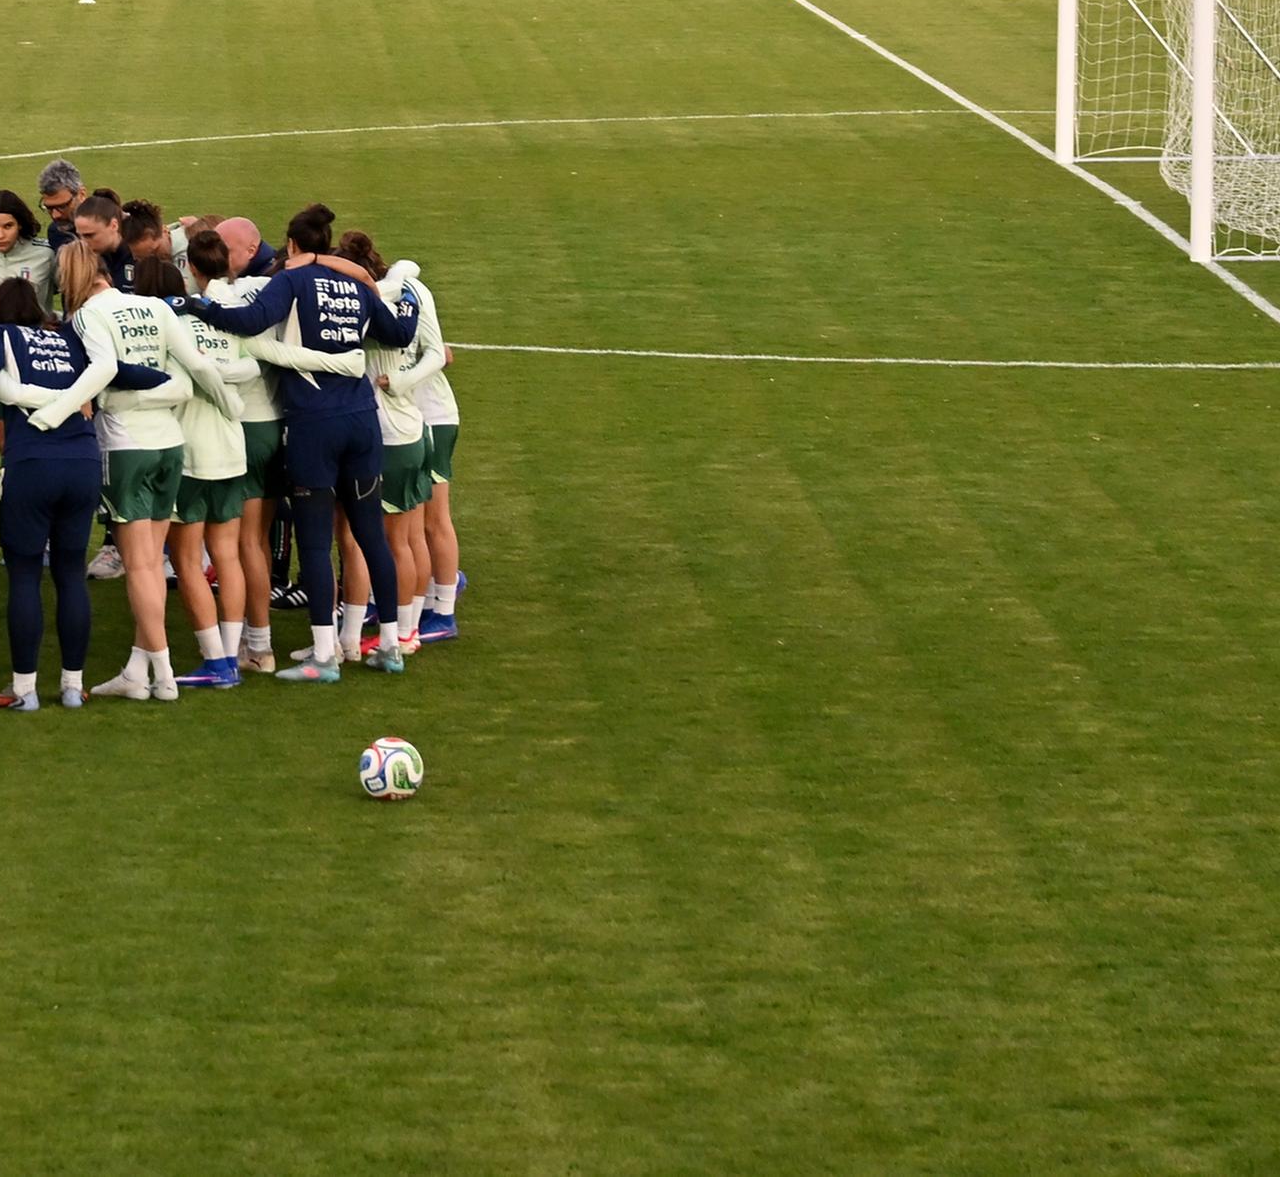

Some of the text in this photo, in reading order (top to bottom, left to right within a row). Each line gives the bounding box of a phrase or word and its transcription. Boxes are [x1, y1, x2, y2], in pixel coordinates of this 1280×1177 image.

[330, 280, 359, 295] TIM
[317, 291, 361, 310] Poste
[126, 307, 154, 320] TIM
[120, 323, 159, 340] Poste
[320, 326, 343, 342] eni
[31, 358, 56, 372] eni
